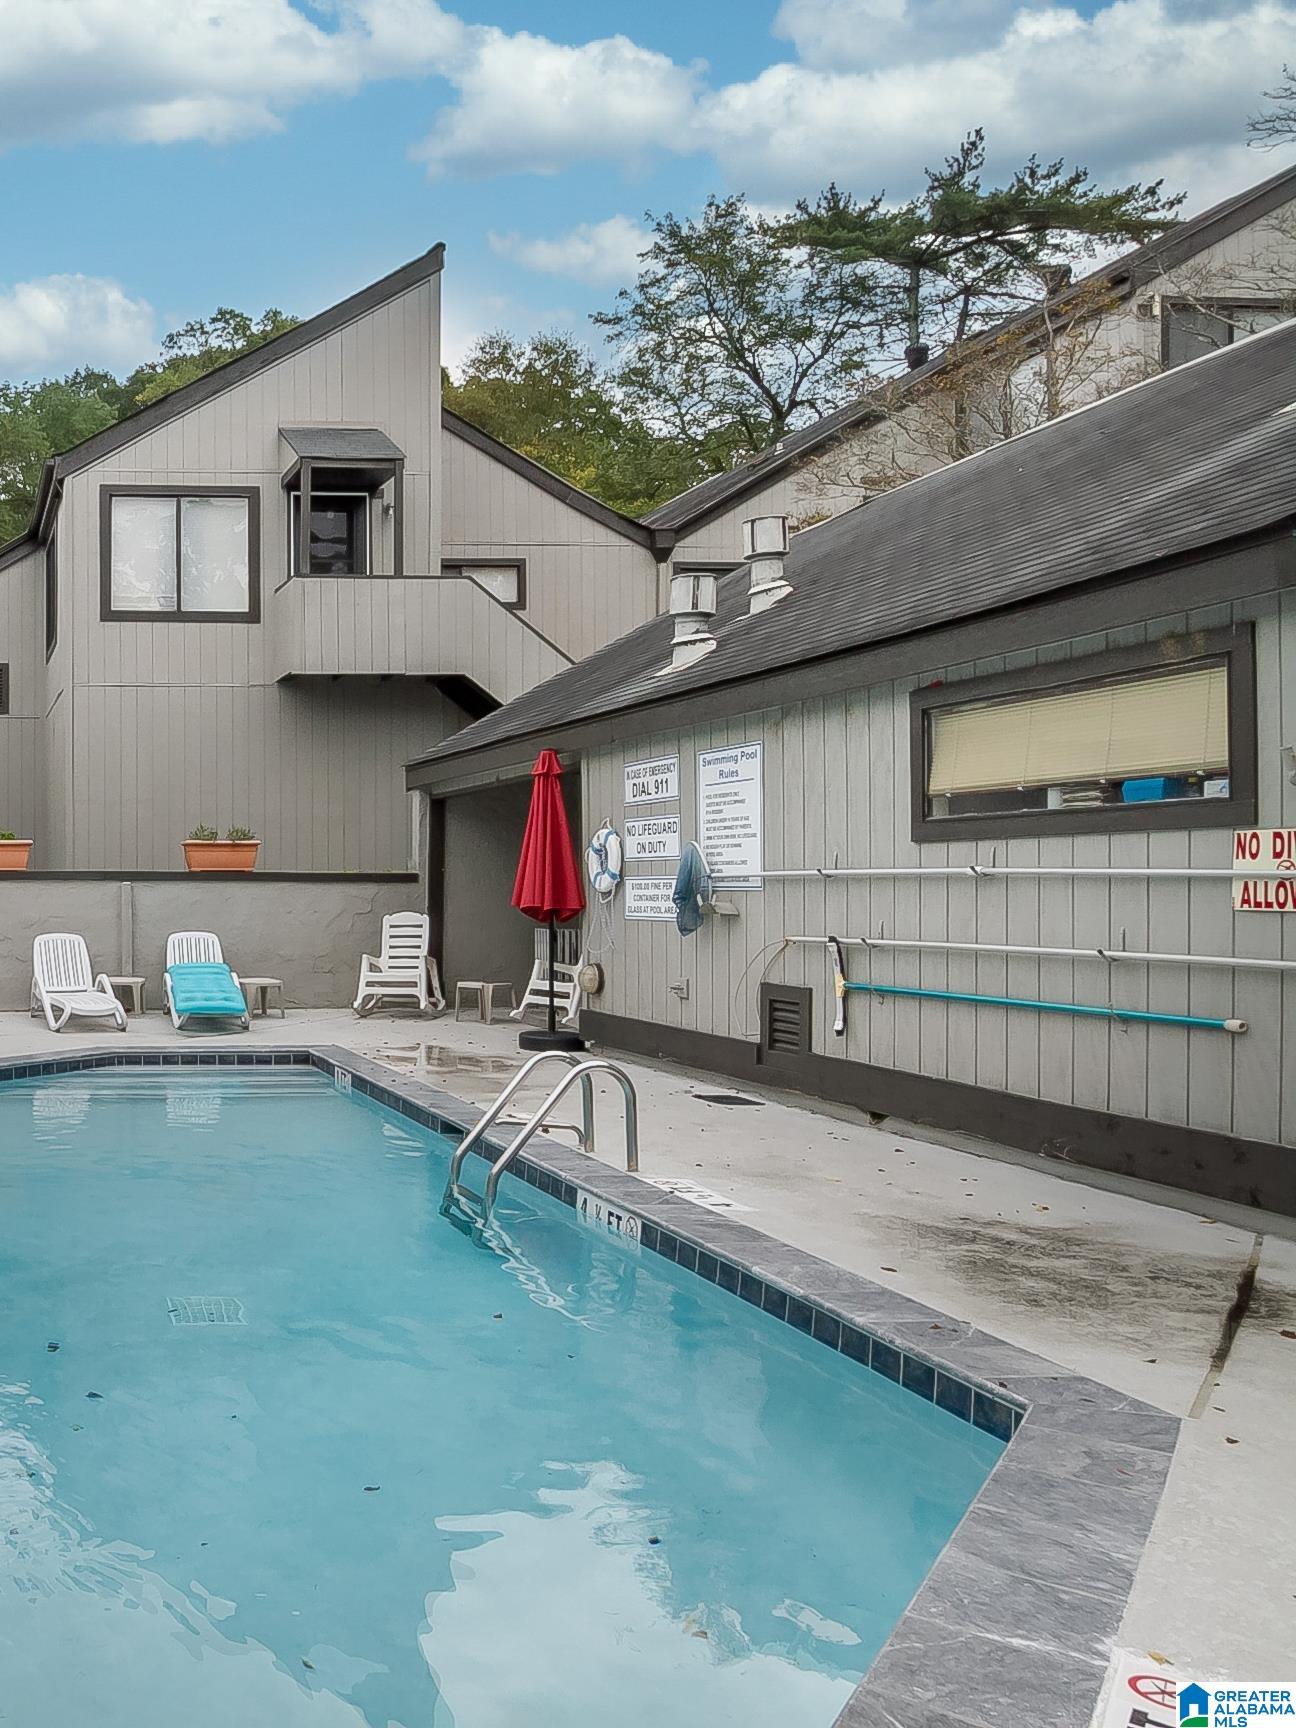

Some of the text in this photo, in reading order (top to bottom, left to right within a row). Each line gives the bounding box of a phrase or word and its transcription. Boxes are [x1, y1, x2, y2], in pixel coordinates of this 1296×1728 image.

[702, 749, 758, 767] Swimming Pool
[718, 768, 739, 779] Rules
[632, 777, 669, 798] DIAL 911
[626, 821, 678, 837] NO LIFEGUARD
[636, 840, 667, 854] ON DUTY
[1235, 830, 1296, 860] NO DI
